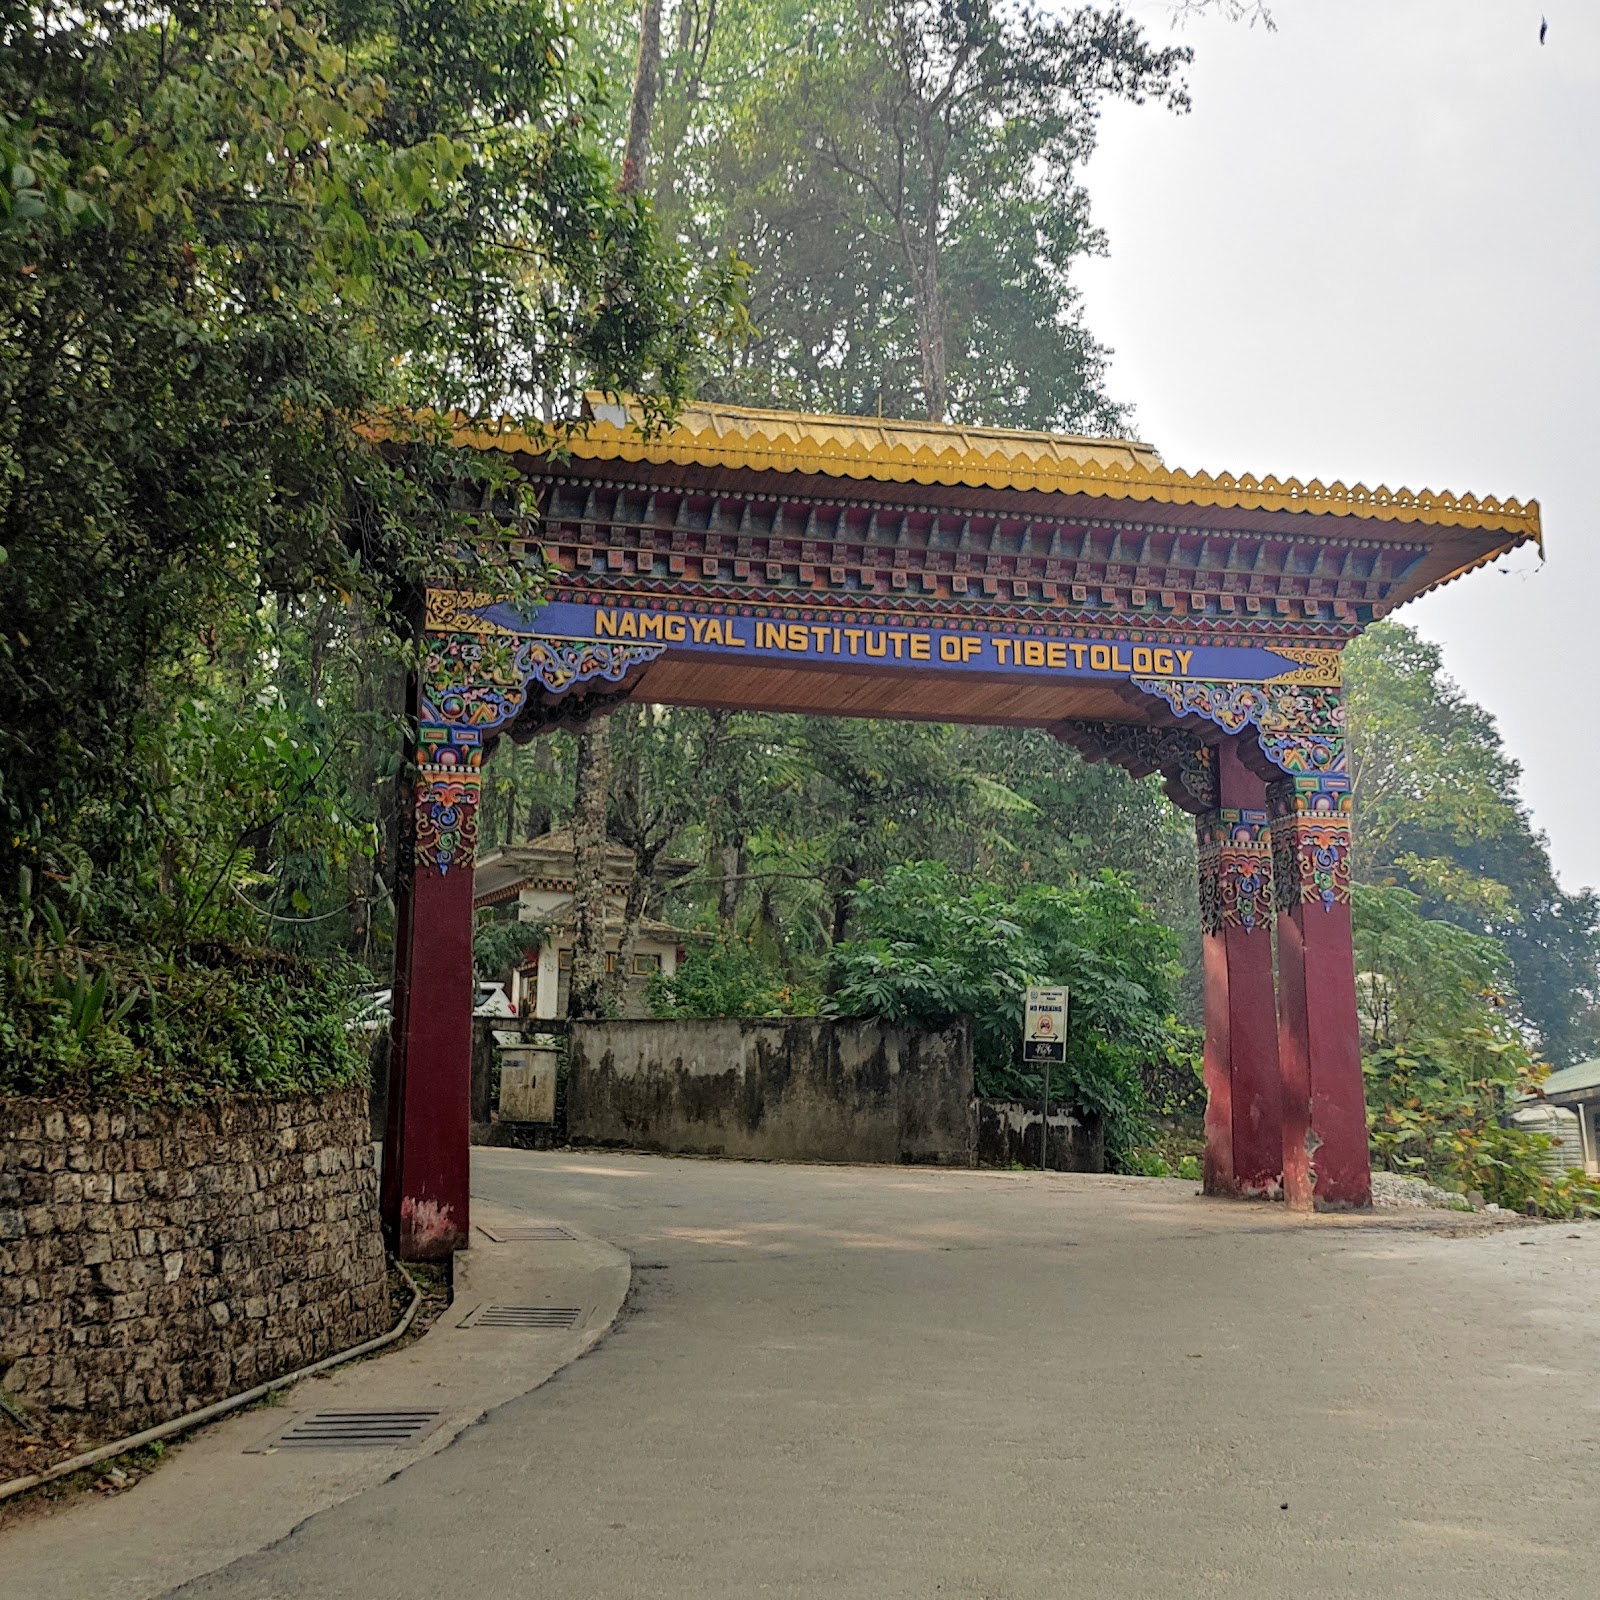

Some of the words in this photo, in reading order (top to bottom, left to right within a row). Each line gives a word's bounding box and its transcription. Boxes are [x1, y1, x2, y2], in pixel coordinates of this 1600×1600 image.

[595, 609, 746, 647] NAMGYAL
[755, 621, 931, 660] INSTITUTE
[940, 635, 982, 662] OF
[991, 638, 1193, 675] TIBETOLOGY
[1029, 1004, 1038, 1012] NO
[1038, 1004, 1062, 1012] PARKING
